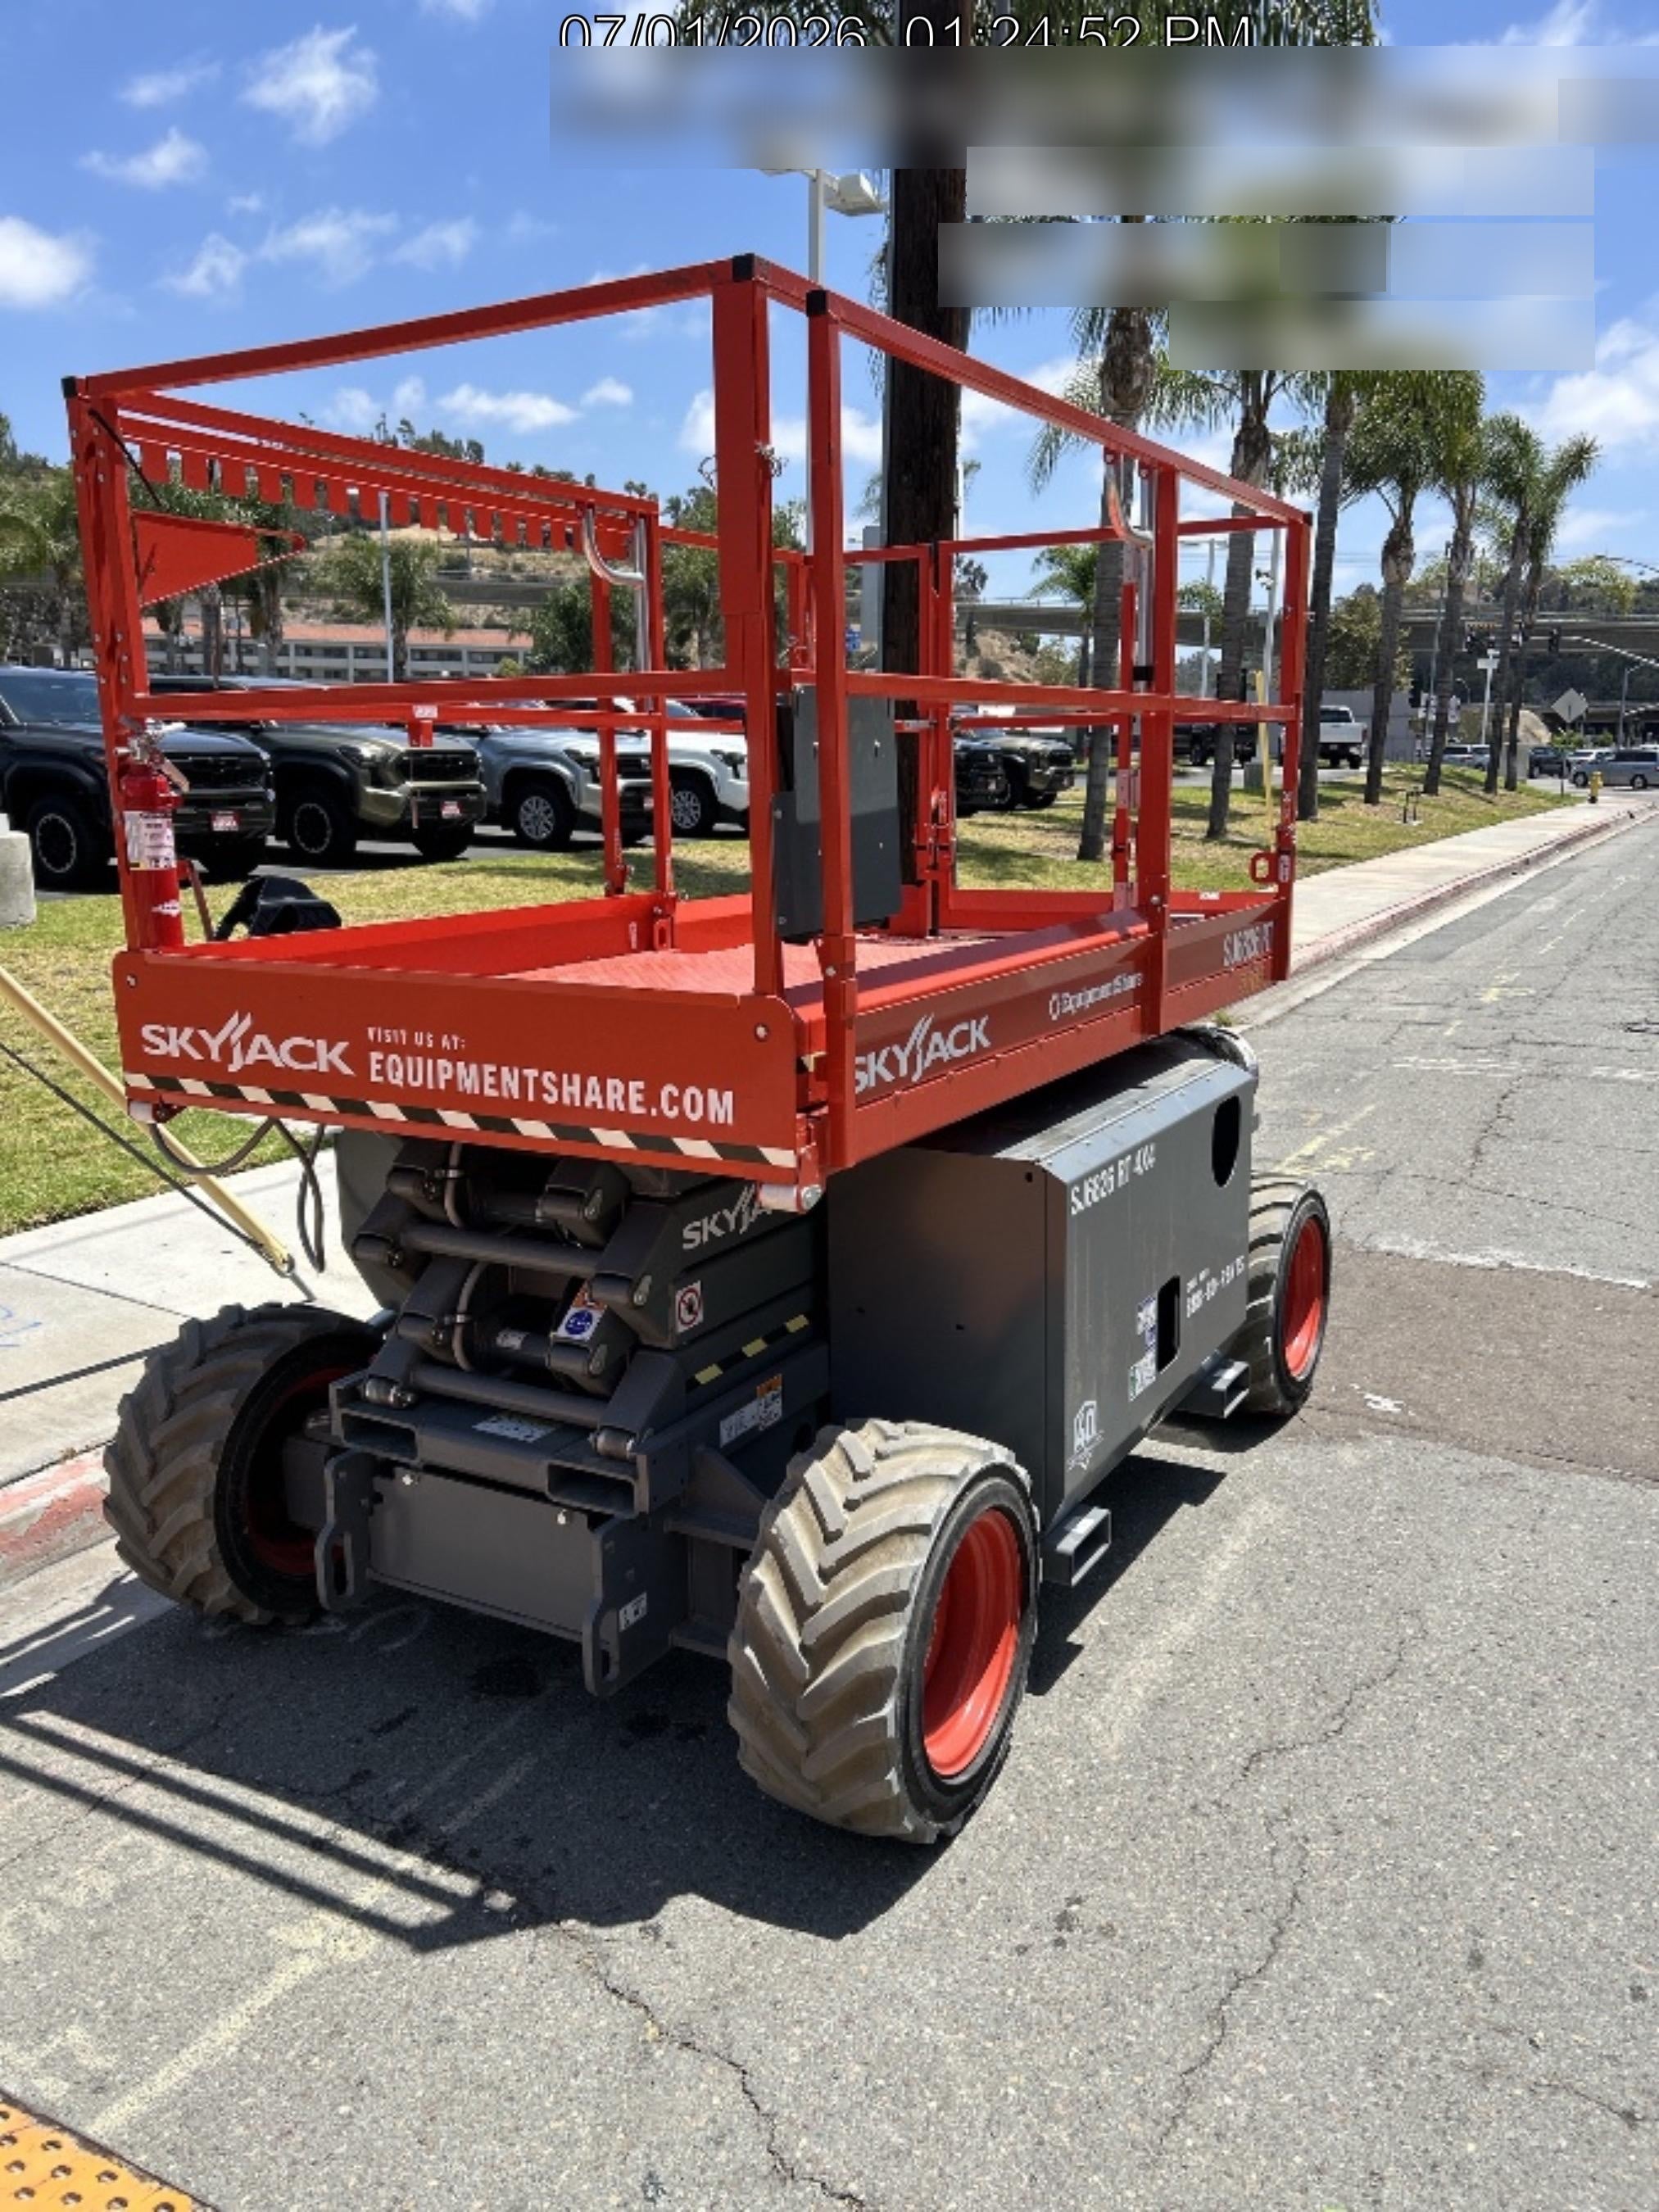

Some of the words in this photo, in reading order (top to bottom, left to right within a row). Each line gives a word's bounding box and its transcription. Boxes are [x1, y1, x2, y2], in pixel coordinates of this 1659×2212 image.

[141, 1009, 356, 1077] SKYJACK
[367, 1027, 408, 1045] VISIT
[414, 1031, 433, 1048] US
[442, 1034, 466, 1051] AT:
[369, 1051, 735, 1126] EQUIPMENTSHARE.COM
